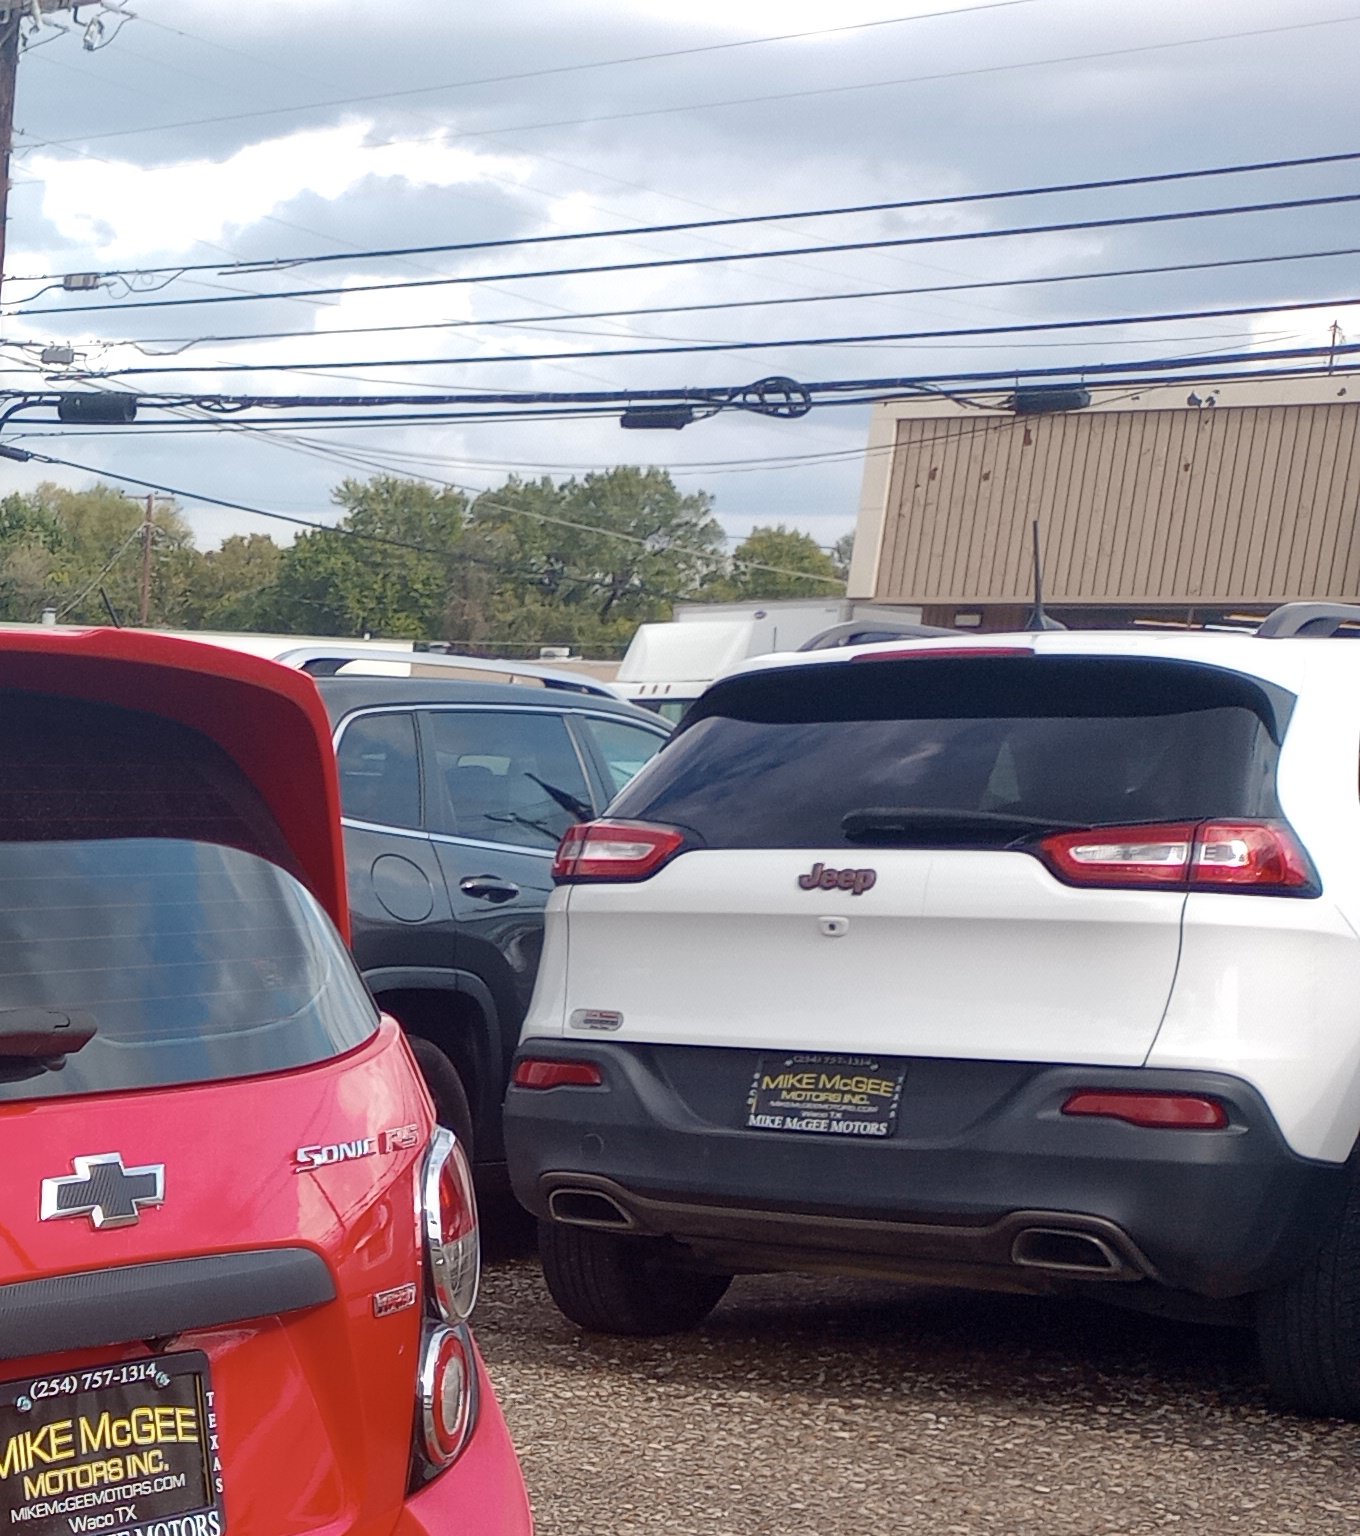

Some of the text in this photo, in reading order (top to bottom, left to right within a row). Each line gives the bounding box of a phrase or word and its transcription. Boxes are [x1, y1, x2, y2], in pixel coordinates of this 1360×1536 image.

[798, 862, 877, 896] Jeep
[762, 1073, 896, 1097] MIKE McGEE
[781, 1090, 871, 1105] MOTORS INC.
[380, 1123, 419, 1154] RS
[748, 1115, 888, 1136] MIKE McGEE MOTORS
[30, 1362, 158, 1400] (254) 757-1314
[79, 1407, 199, 1455] McGEE
[205, 1391, 224, 1493] TEXAS
[23, 1450, 170, 1502] MOTORS INC.
[68, 1504, 138, 1534] Waco TX
